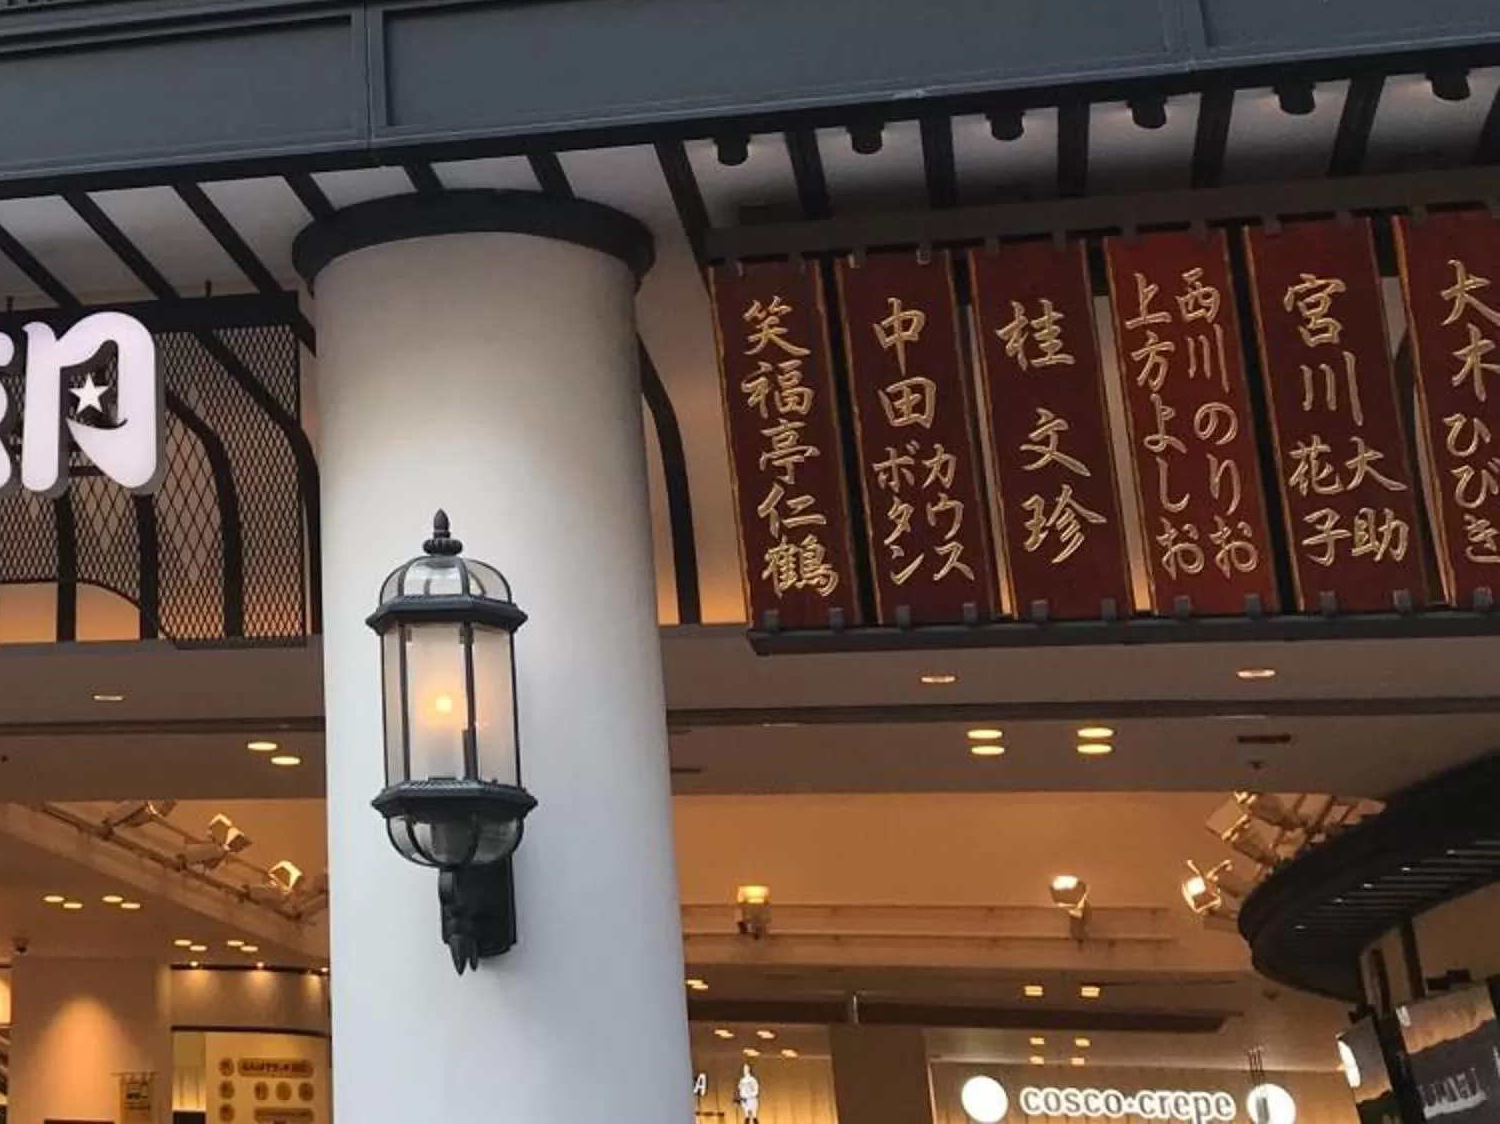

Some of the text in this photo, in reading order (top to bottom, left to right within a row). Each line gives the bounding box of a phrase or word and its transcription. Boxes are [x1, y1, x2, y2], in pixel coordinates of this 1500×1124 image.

[741, 295, 839, 598] 笑福亭仁鶴
[1126, 272, 1205, 580] 上方よしお
[1176, 267, 1259, 579] 西川のりお
